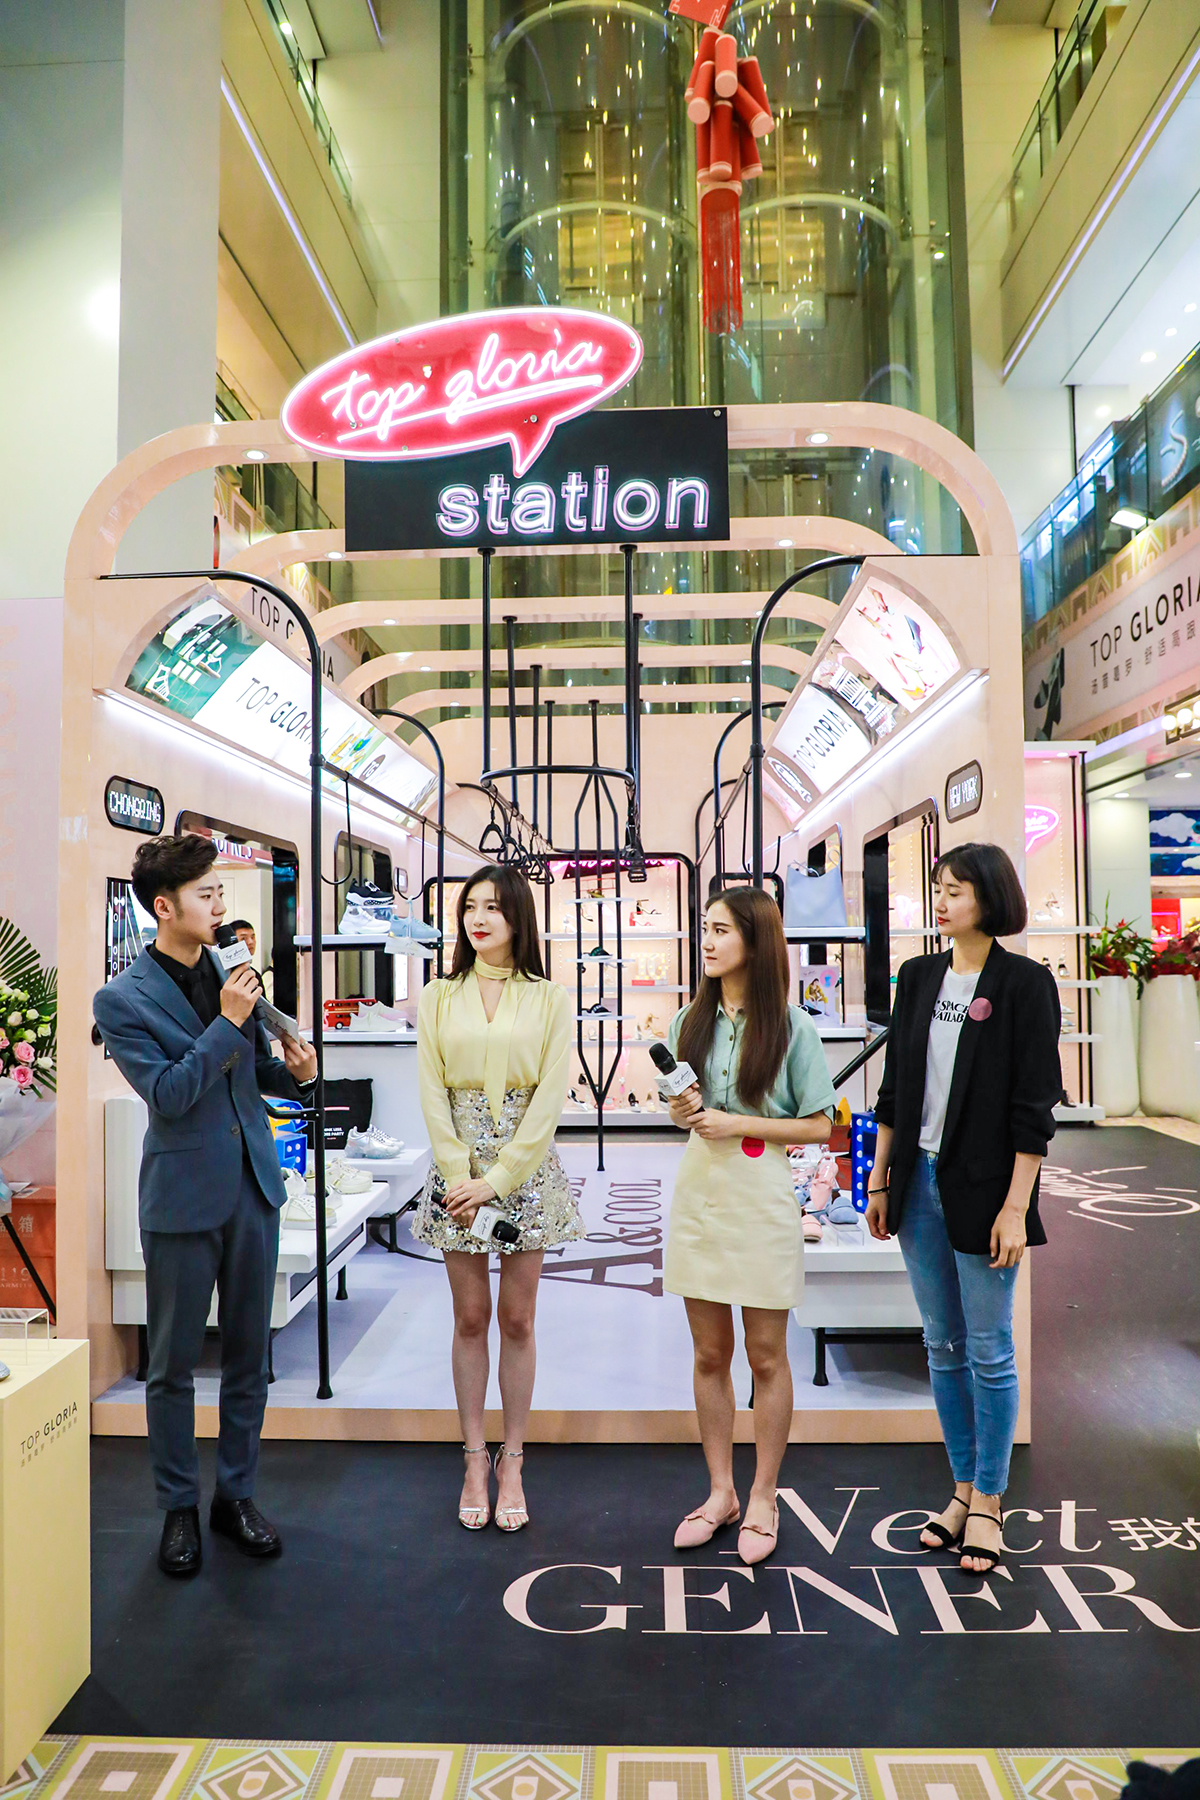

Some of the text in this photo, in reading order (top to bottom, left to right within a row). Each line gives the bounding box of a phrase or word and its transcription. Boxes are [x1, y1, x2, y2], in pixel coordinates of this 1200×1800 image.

[322, 329, 602, 441] top gloria
[436, 465, 709, 537] station
[251, 586, 280, 632] TOP
[1090, 576, 1200, 668] TOP GLORI
[236, 677, 279, 714] TOP
[805, 708, 852, 757] GLORIA
[109, 790, 161, 823] CHONGQING
[20, 1430, 40, 1455] TOP
[43, 1401, 78, 1437] GLORIA
[1106, 1516, 1200, 1552] 我
[502, 1563, 1200, 1635] GENER
